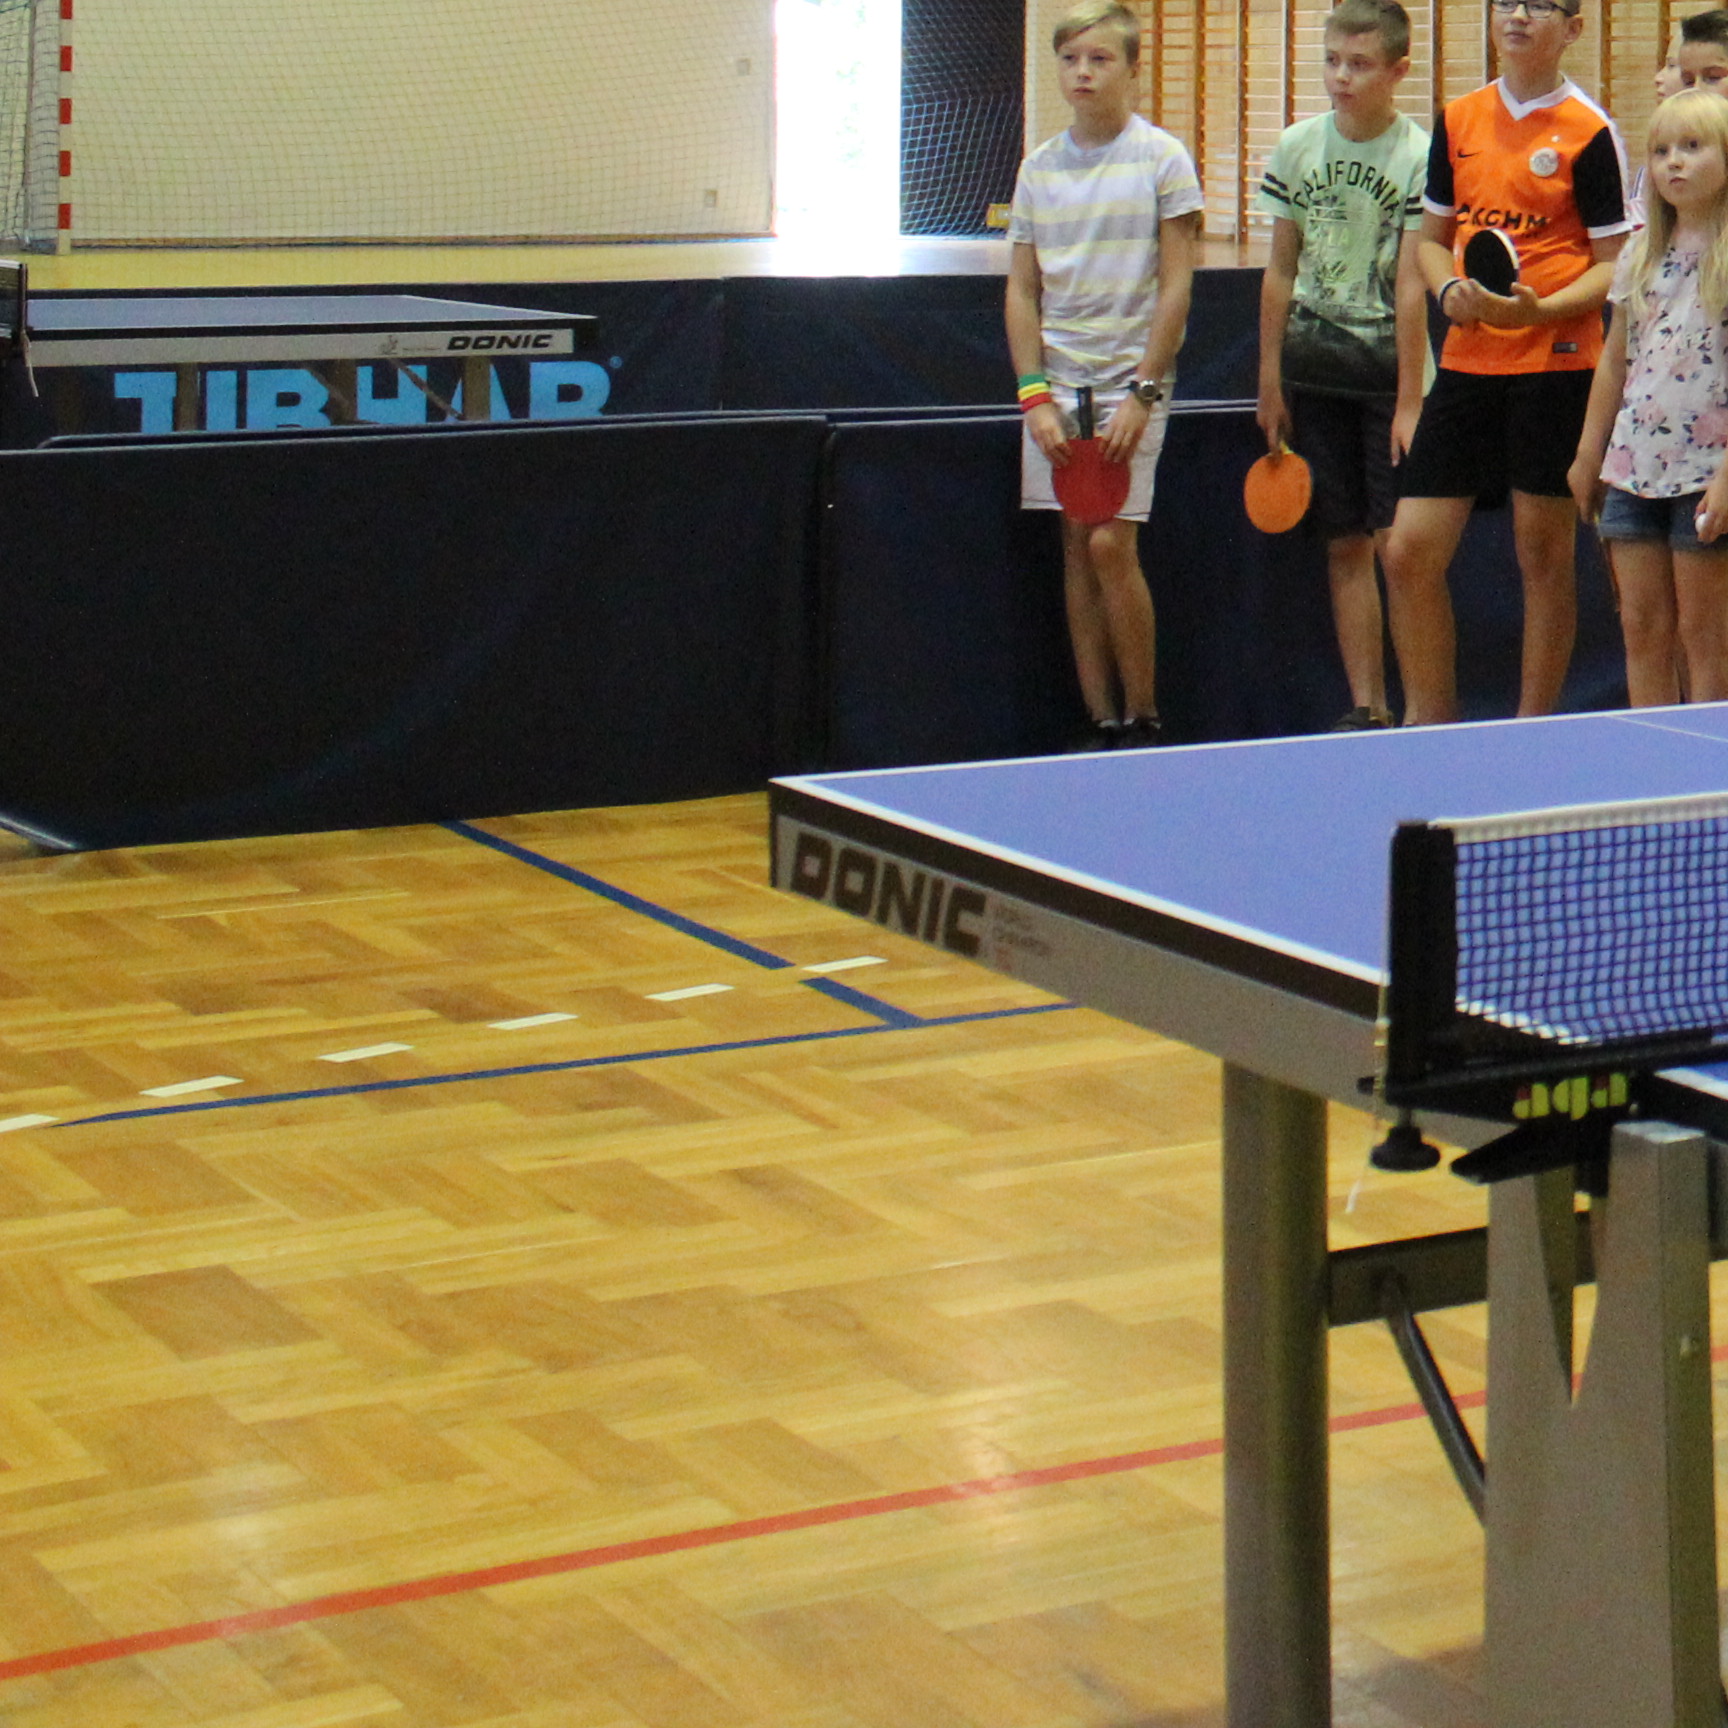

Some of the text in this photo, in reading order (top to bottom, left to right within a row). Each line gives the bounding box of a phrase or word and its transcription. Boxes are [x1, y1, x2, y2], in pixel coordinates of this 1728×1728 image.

[1292, 159, 1400, 220] CALIFORNIA
[447, 334, 553, 351] DONIC
[790, 830, 987, 960] DONIC
